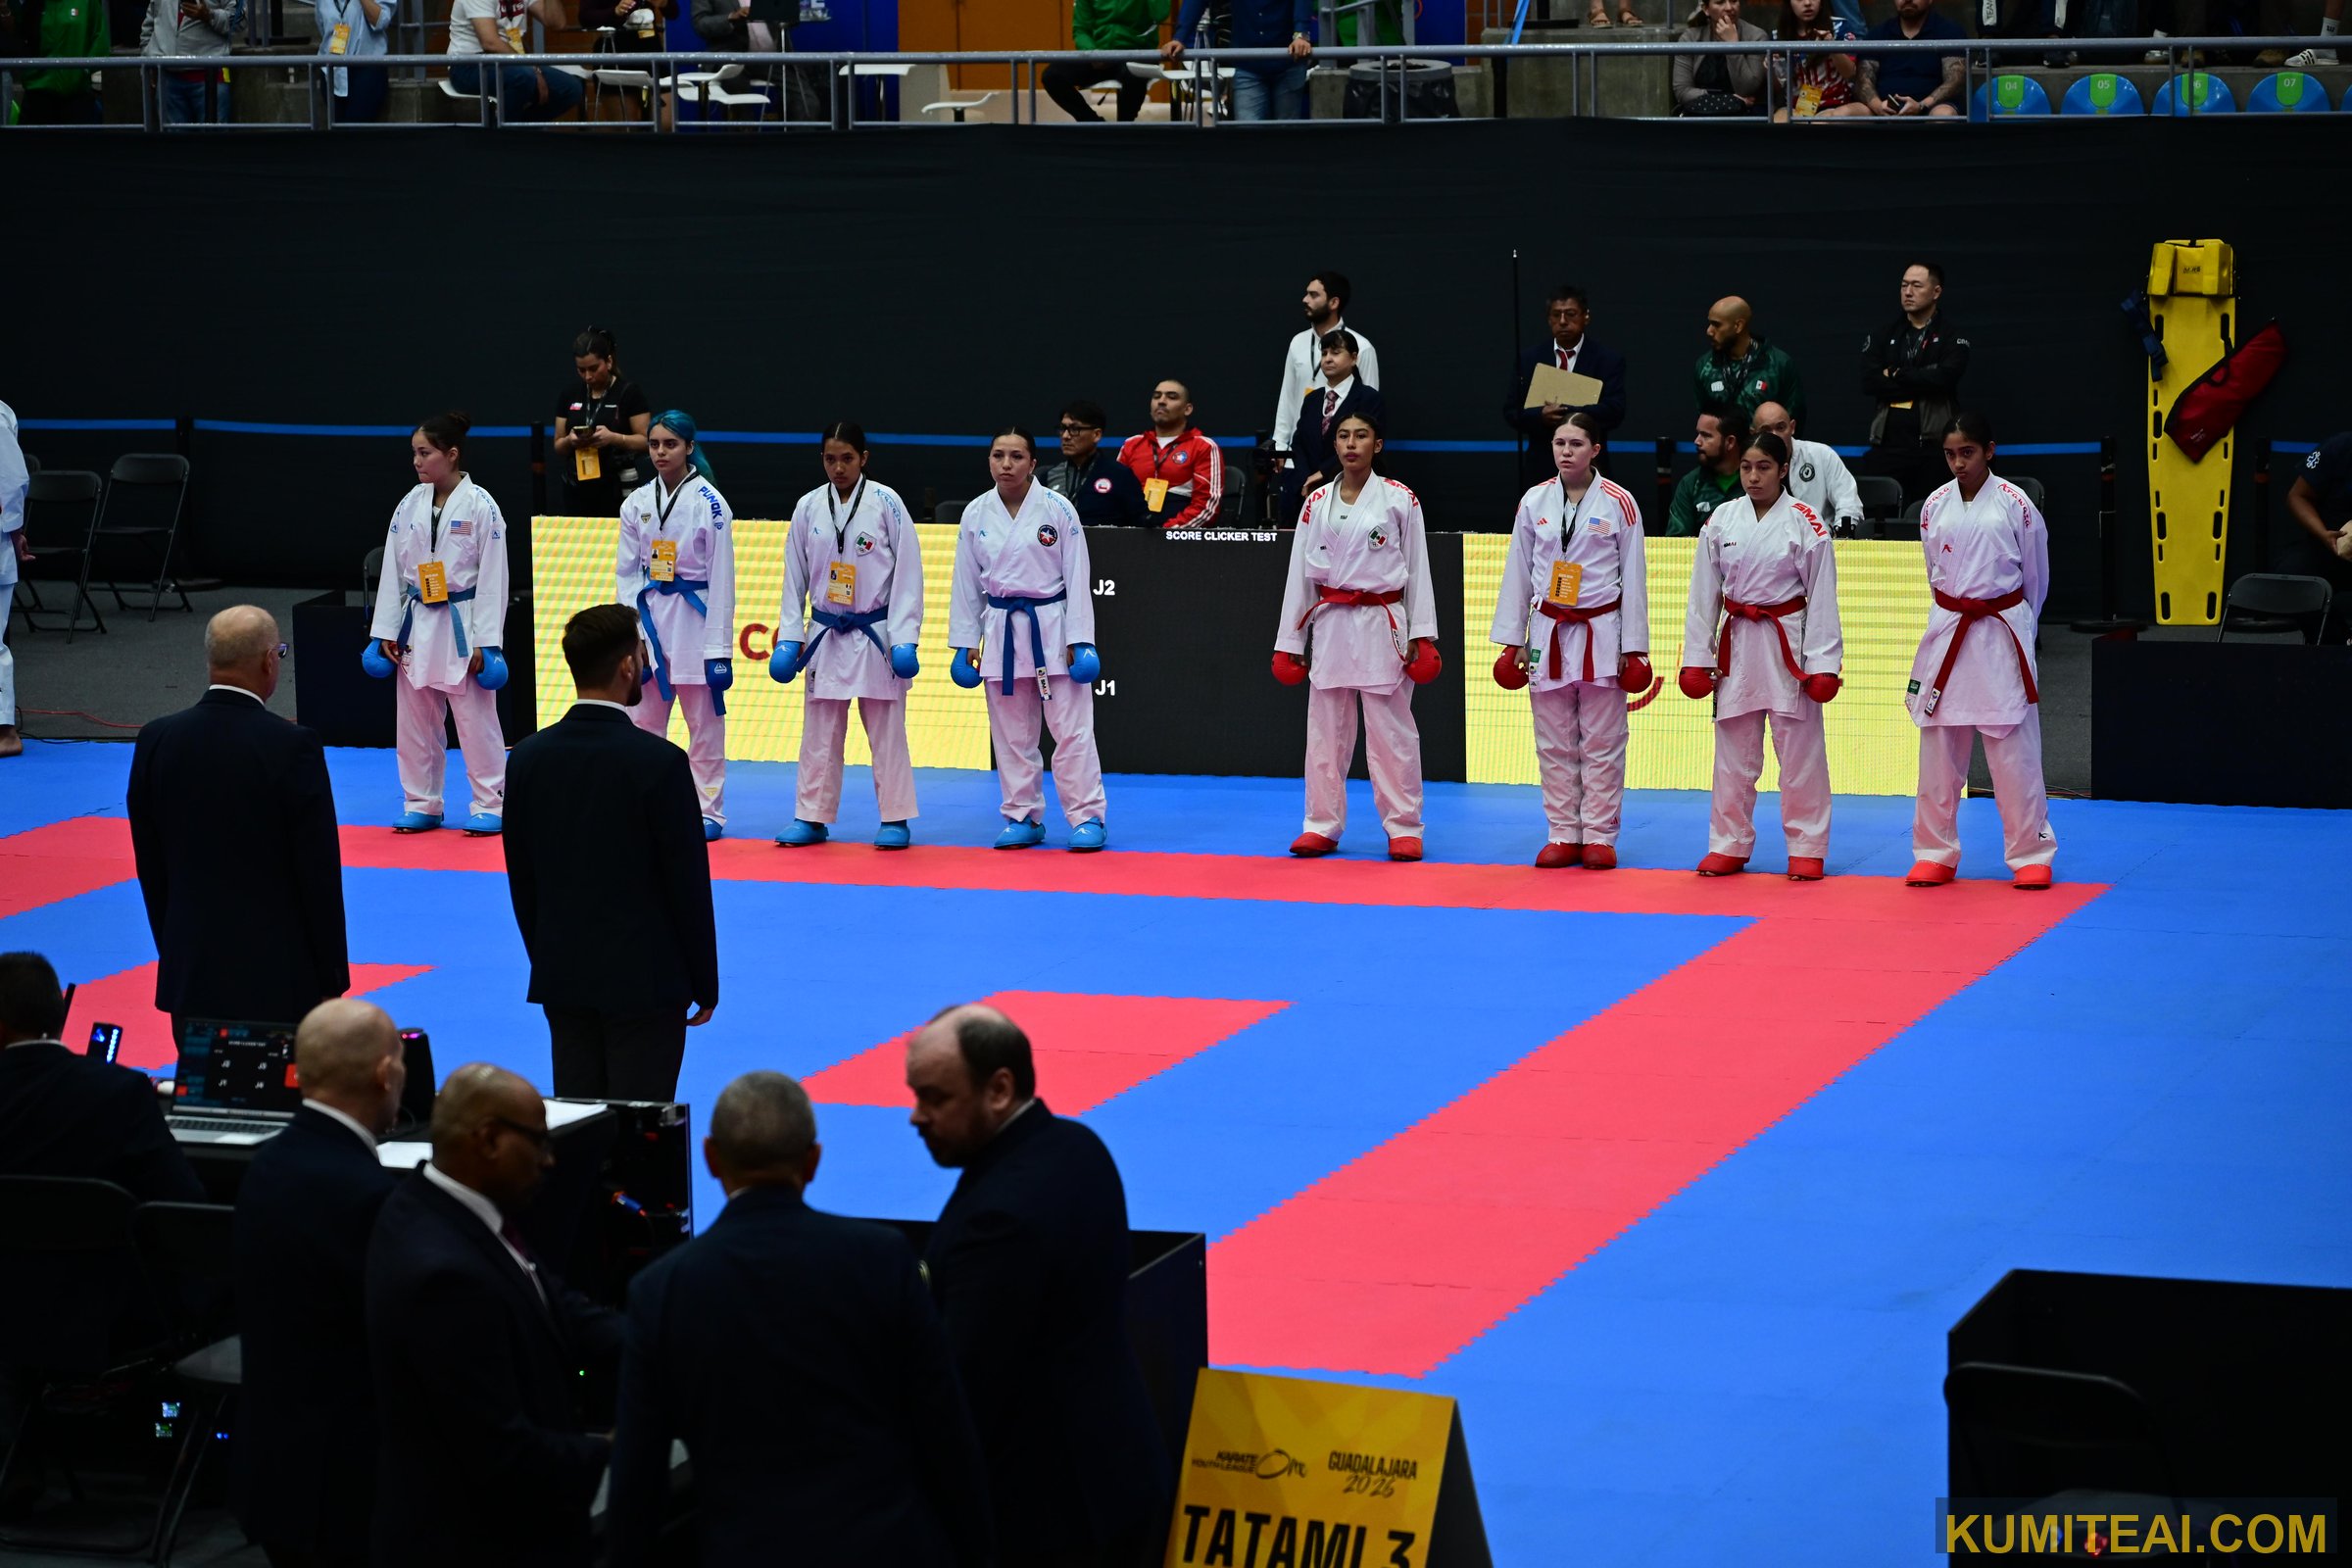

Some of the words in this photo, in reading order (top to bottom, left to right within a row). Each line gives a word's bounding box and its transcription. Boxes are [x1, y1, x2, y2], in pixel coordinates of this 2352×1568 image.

[2005, 81, 2018, 91] 04
[2097, 80, 2110, 90] 05
[2283, 78, 2297, 88] 07
[698, 485, 723, 519] PUNOK
[1301, 488, 1327, 525] SMAI
[1790, 502, 1828, 538] SMAI
[1165, 530, 1202, 541] SCORE
[1203, 531, 1250, 541] CLICKER
[1250, 532, 1278, 542] TEST
[1093, 579, 1116, 596] J2
[1095, 679, 1116, 696] J1
[1328, 1449, 1418, 1481] GUADALAJARA
[1343, 1473, 1396, 1499] 2026
[1183, 1503, 1367, 1568] TATAMI
[1380, 1530, 1415, 1568] 3
